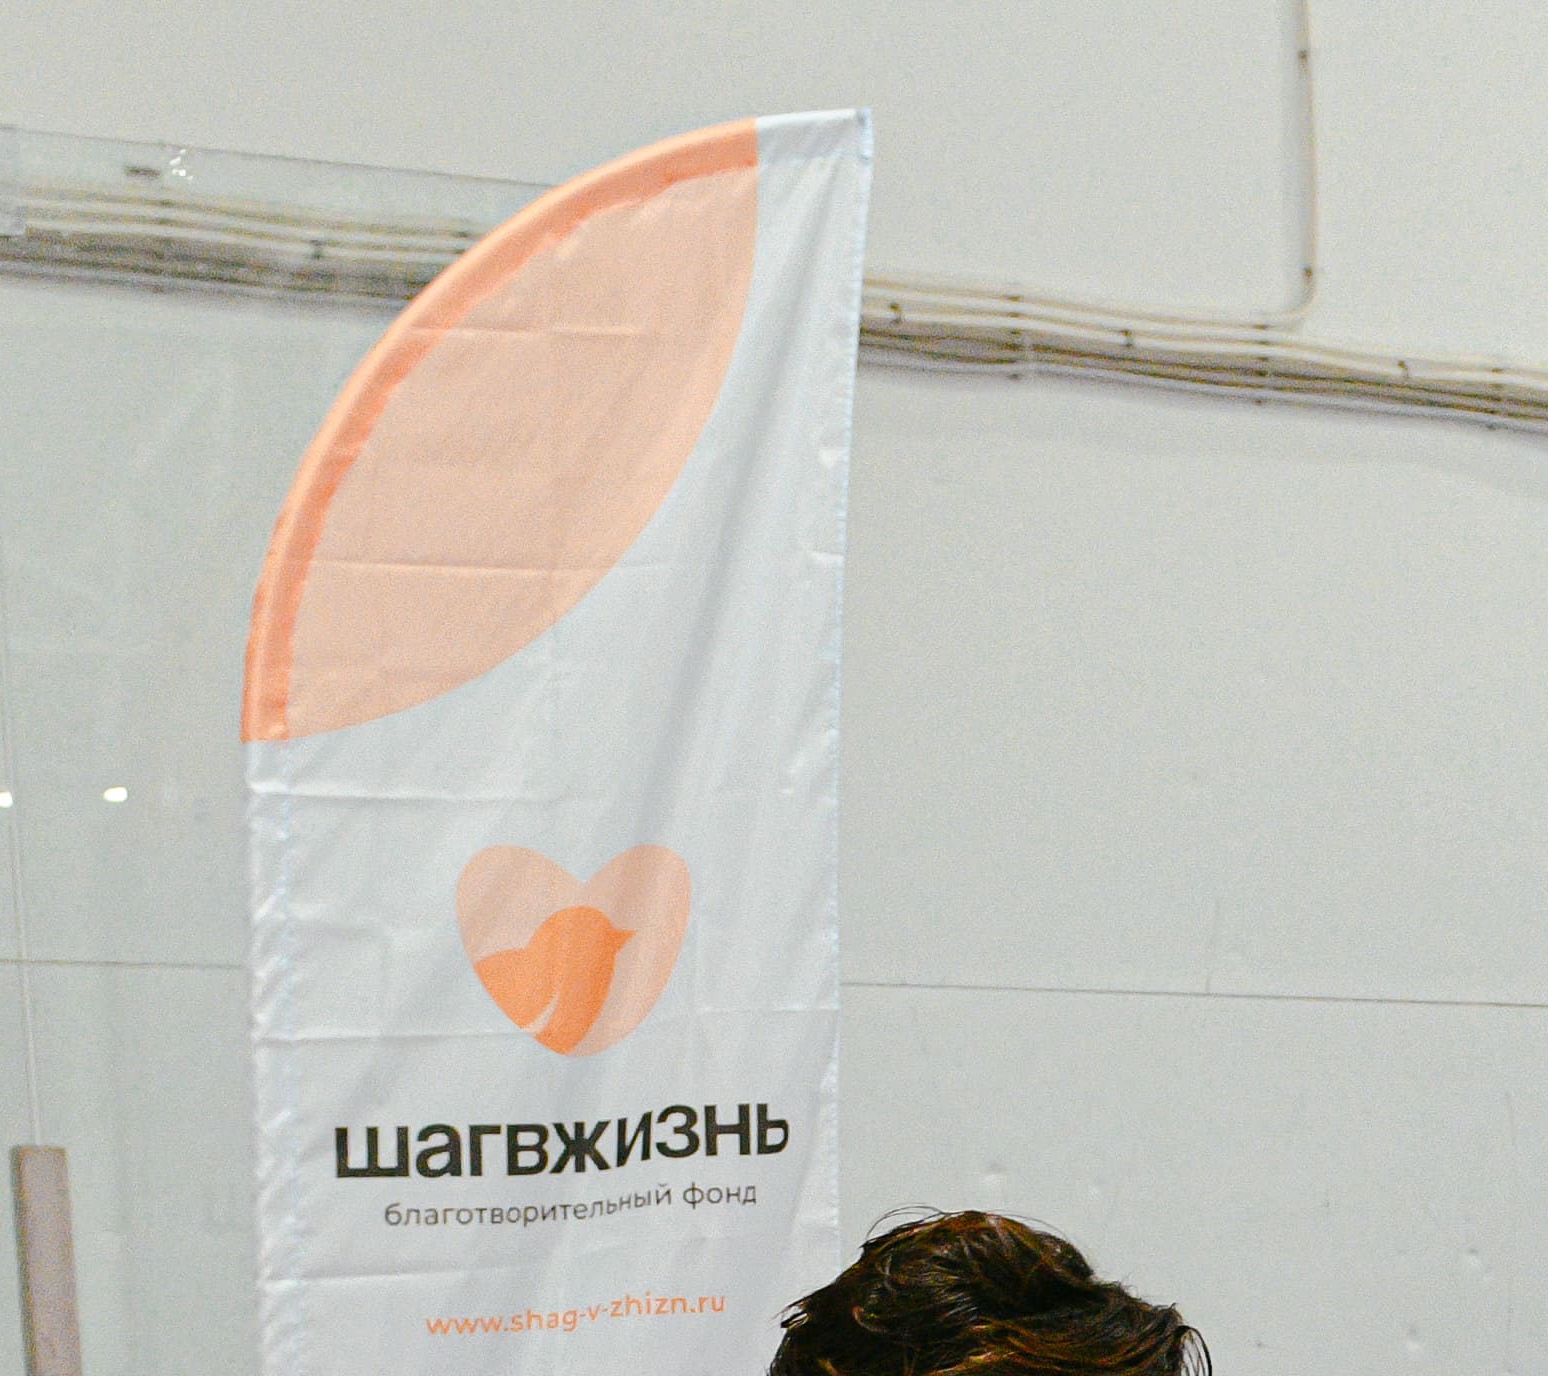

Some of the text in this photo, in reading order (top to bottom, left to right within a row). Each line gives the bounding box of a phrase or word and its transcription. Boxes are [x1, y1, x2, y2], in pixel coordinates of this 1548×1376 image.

[334, 1102, 790, 1179] шагвжизнь
[383, 1181, 757, 1228] благотворительный фонд
[426, 1292, 727, 1336] www.shag-v-zhizn.ru
